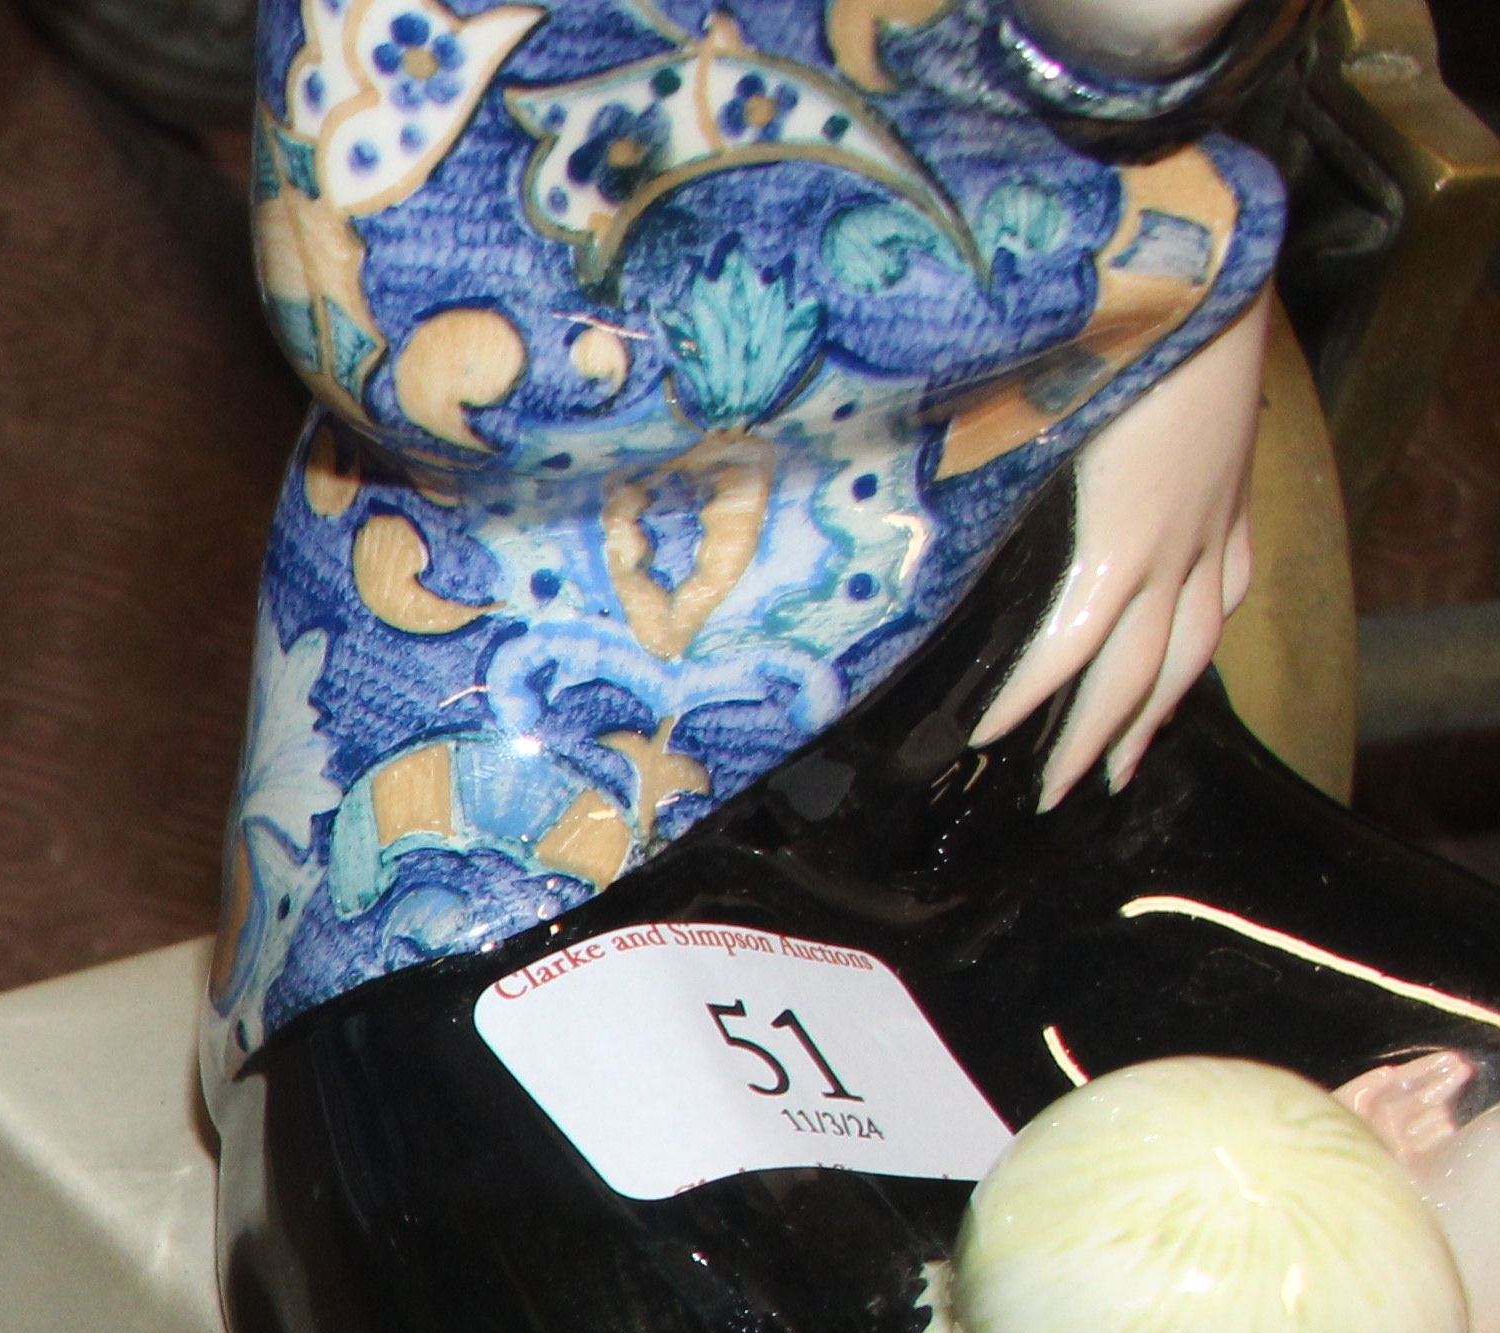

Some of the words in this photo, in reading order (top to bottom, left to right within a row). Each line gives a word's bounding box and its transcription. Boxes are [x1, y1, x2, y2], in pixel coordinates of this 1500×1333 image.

[493, 942, 606, 1000] Clarke
[612, 923, 668, 952] and
[671, 922, 775, 957] Simpson
[780, 934, 875, 971] Auctions
[706, 998, 865, 1104] 51
[781, 1107, 885, 1141] 11/3/24
